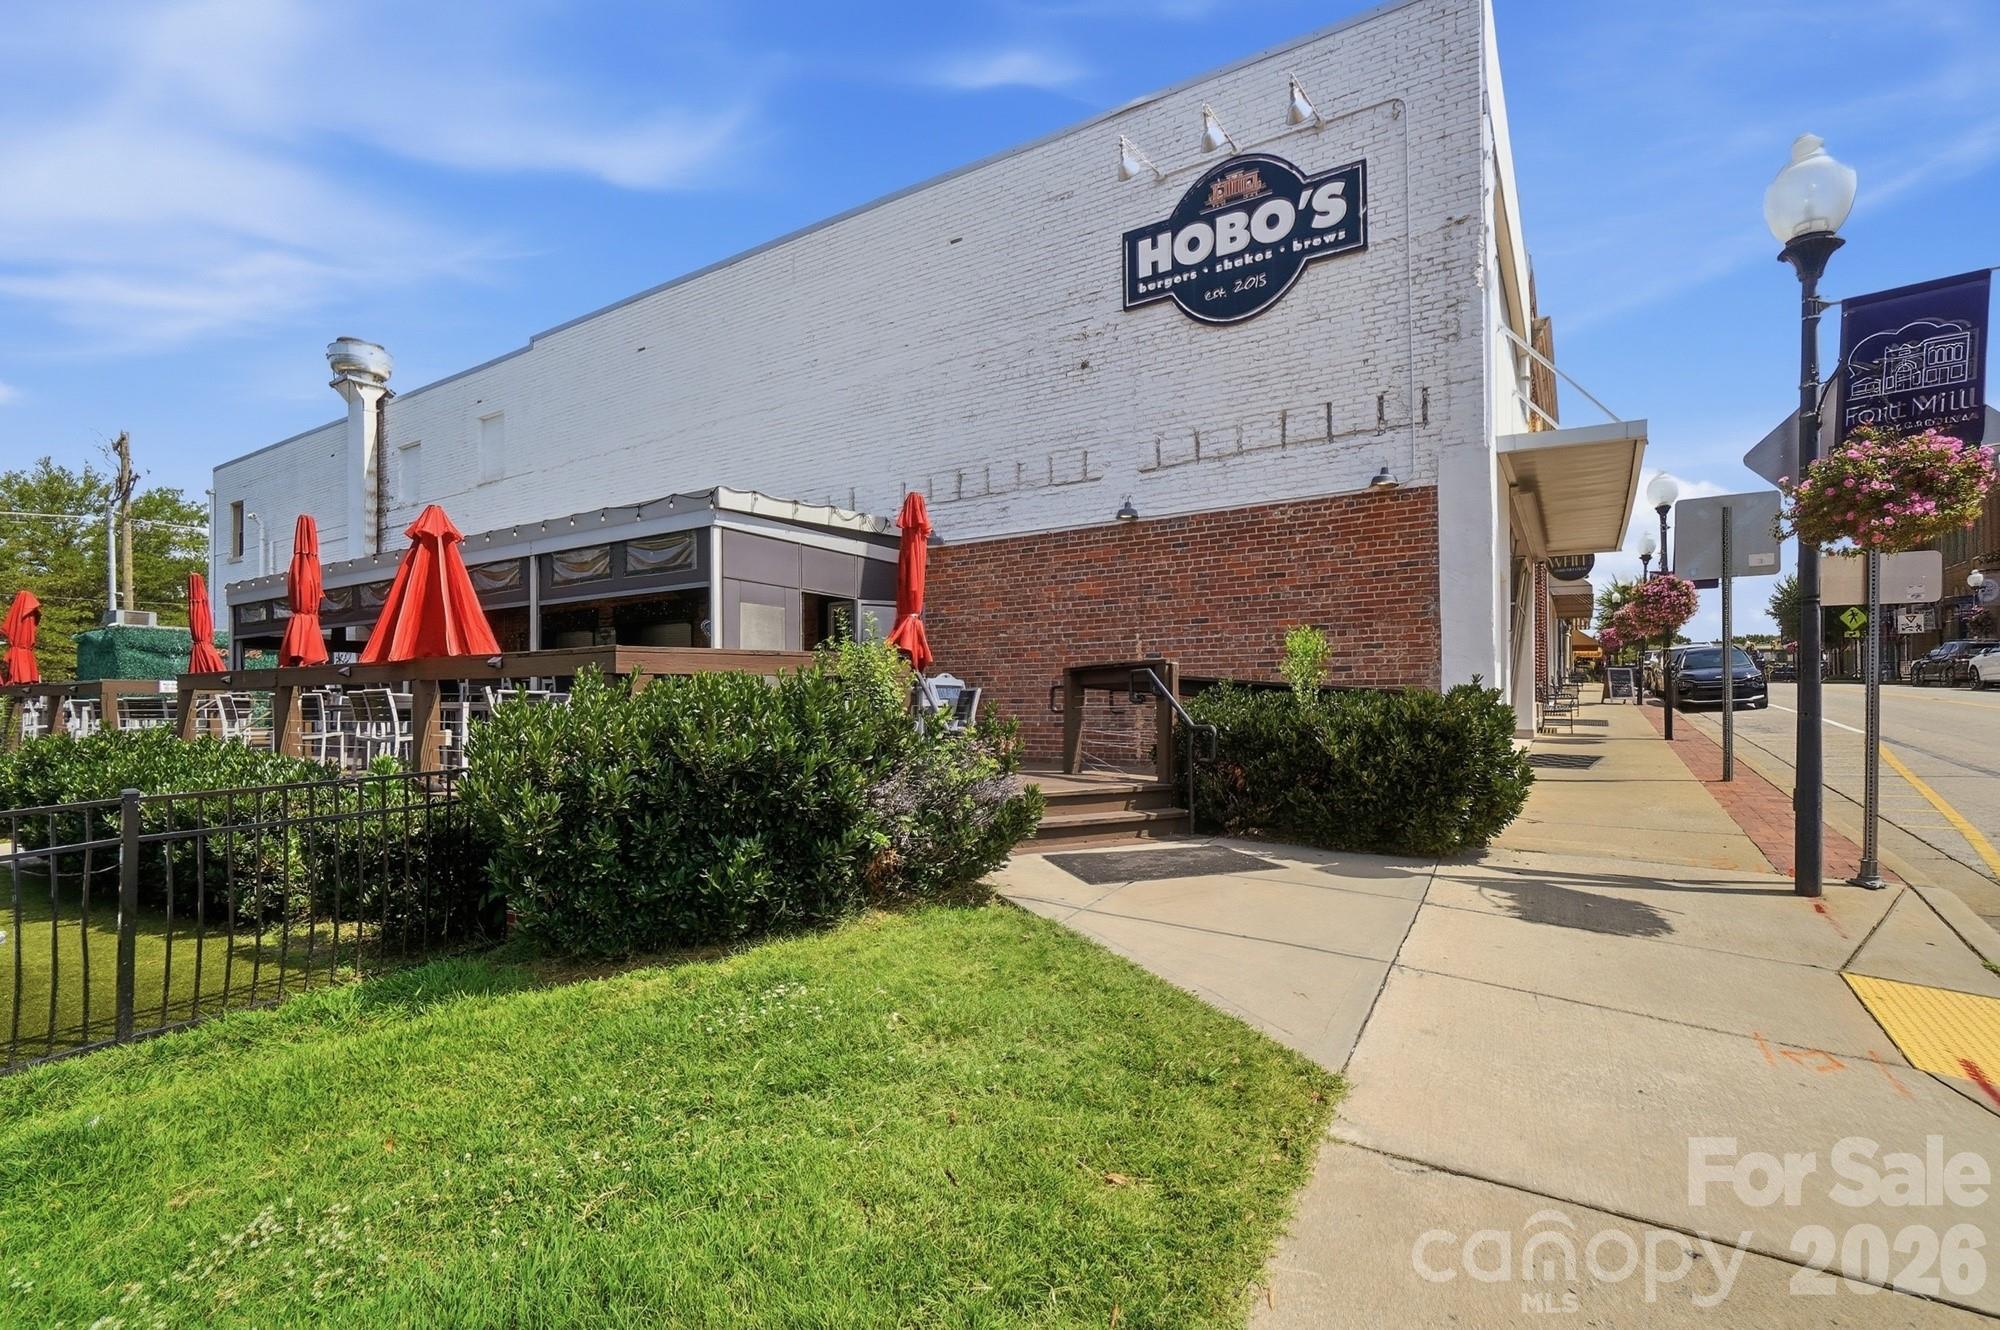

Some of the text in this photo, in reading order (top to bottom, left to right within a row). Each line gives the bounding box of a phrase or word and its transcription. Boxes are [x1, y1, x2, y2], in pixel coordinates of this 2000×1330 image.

[1137, 180, 1347, 279] HOBO'S
[1137, 230, 1346, 294] burgers shakes brews
[1232, 272, 1268, 293] 2015
[1911, 388, 1974, 416] Mill
